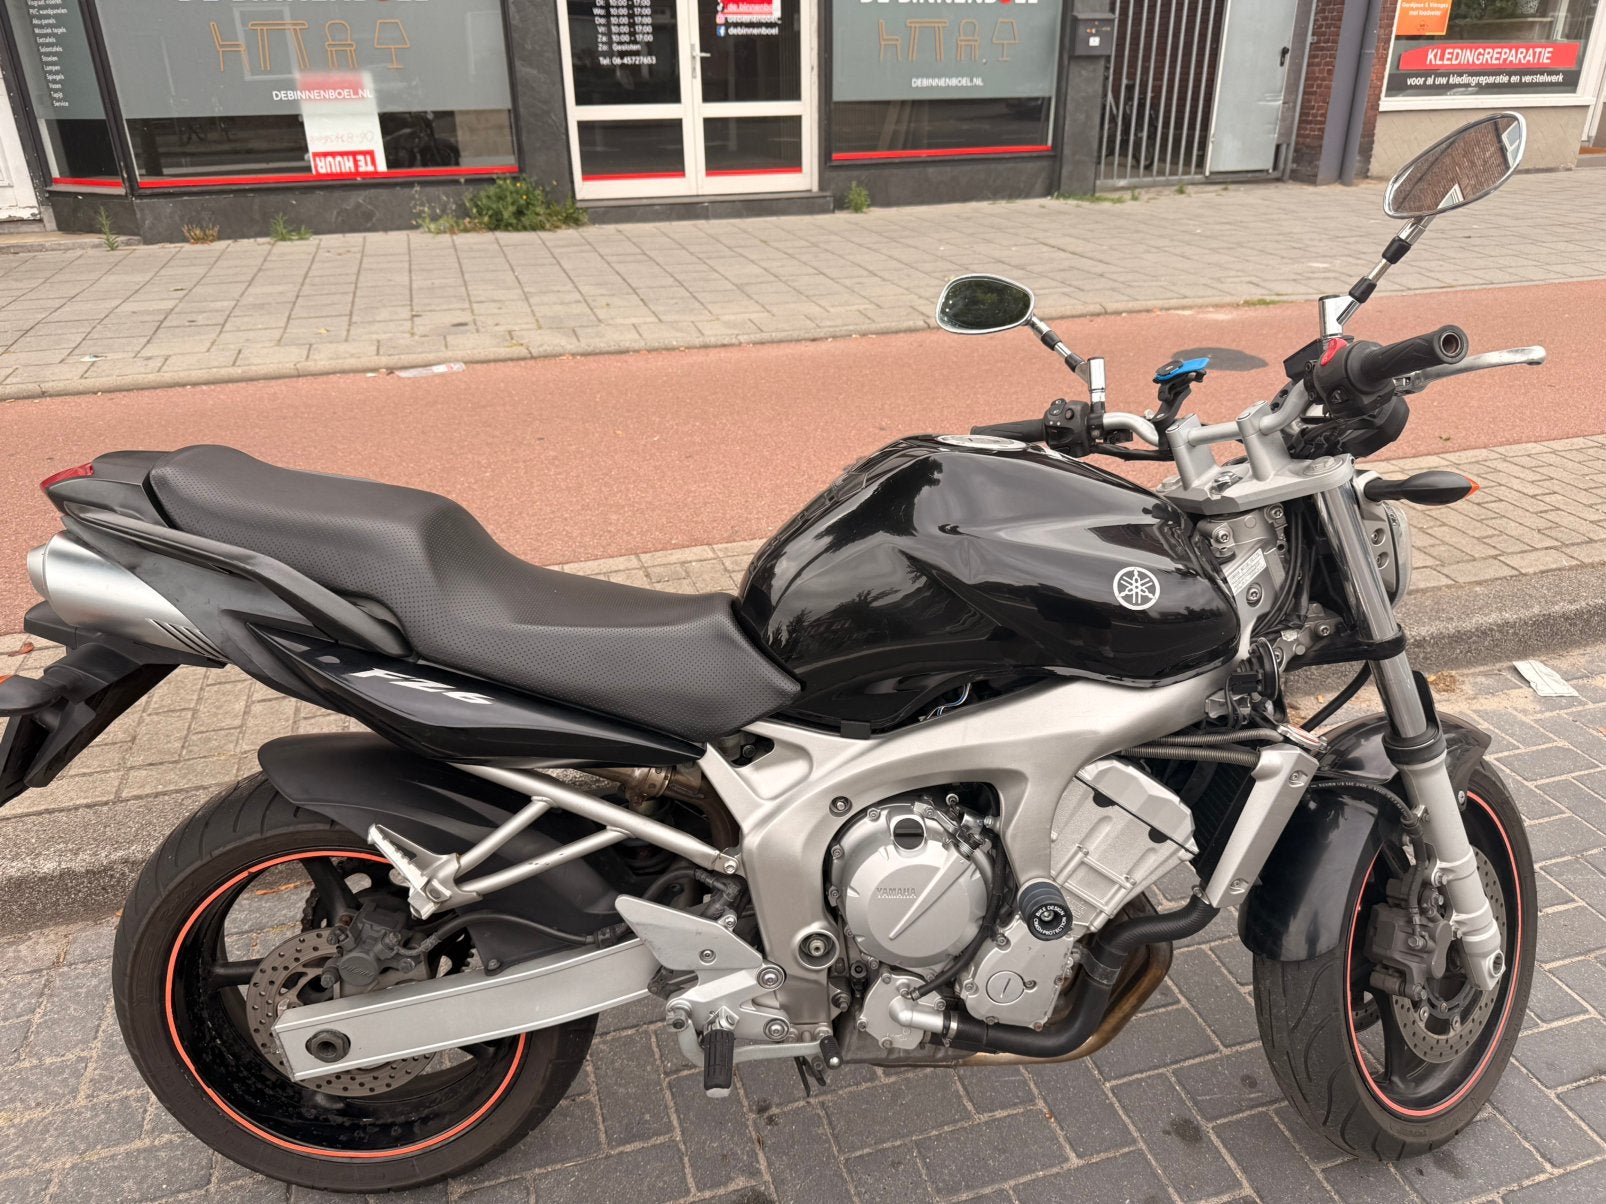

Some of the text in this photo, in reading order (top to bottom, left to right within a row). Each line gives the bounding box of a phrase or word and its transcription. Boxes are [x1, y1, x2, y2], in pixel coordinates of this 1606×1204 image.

[728, 26, 778, 35] debinnenboel
[1426, 47, 1554, 65] KLEDINGREPARATIE
[911, 77, 984, 87] DEBINNENBOEL.NL
[1407, 77, 1424, 85] voor
[1426, 75, 1435, 85] al
[1449, 74, 1509, 86] kledingreparatie
[1522, 73, 1564, 83] verstelwerk
[272, 89, 374, 101] DEBINNENBOEL.NL
[315, 154, 375, 174] TE HUUR
[349, 668, 495, 704] FZ6
[877, 888, 917, 898] YAMAHA
